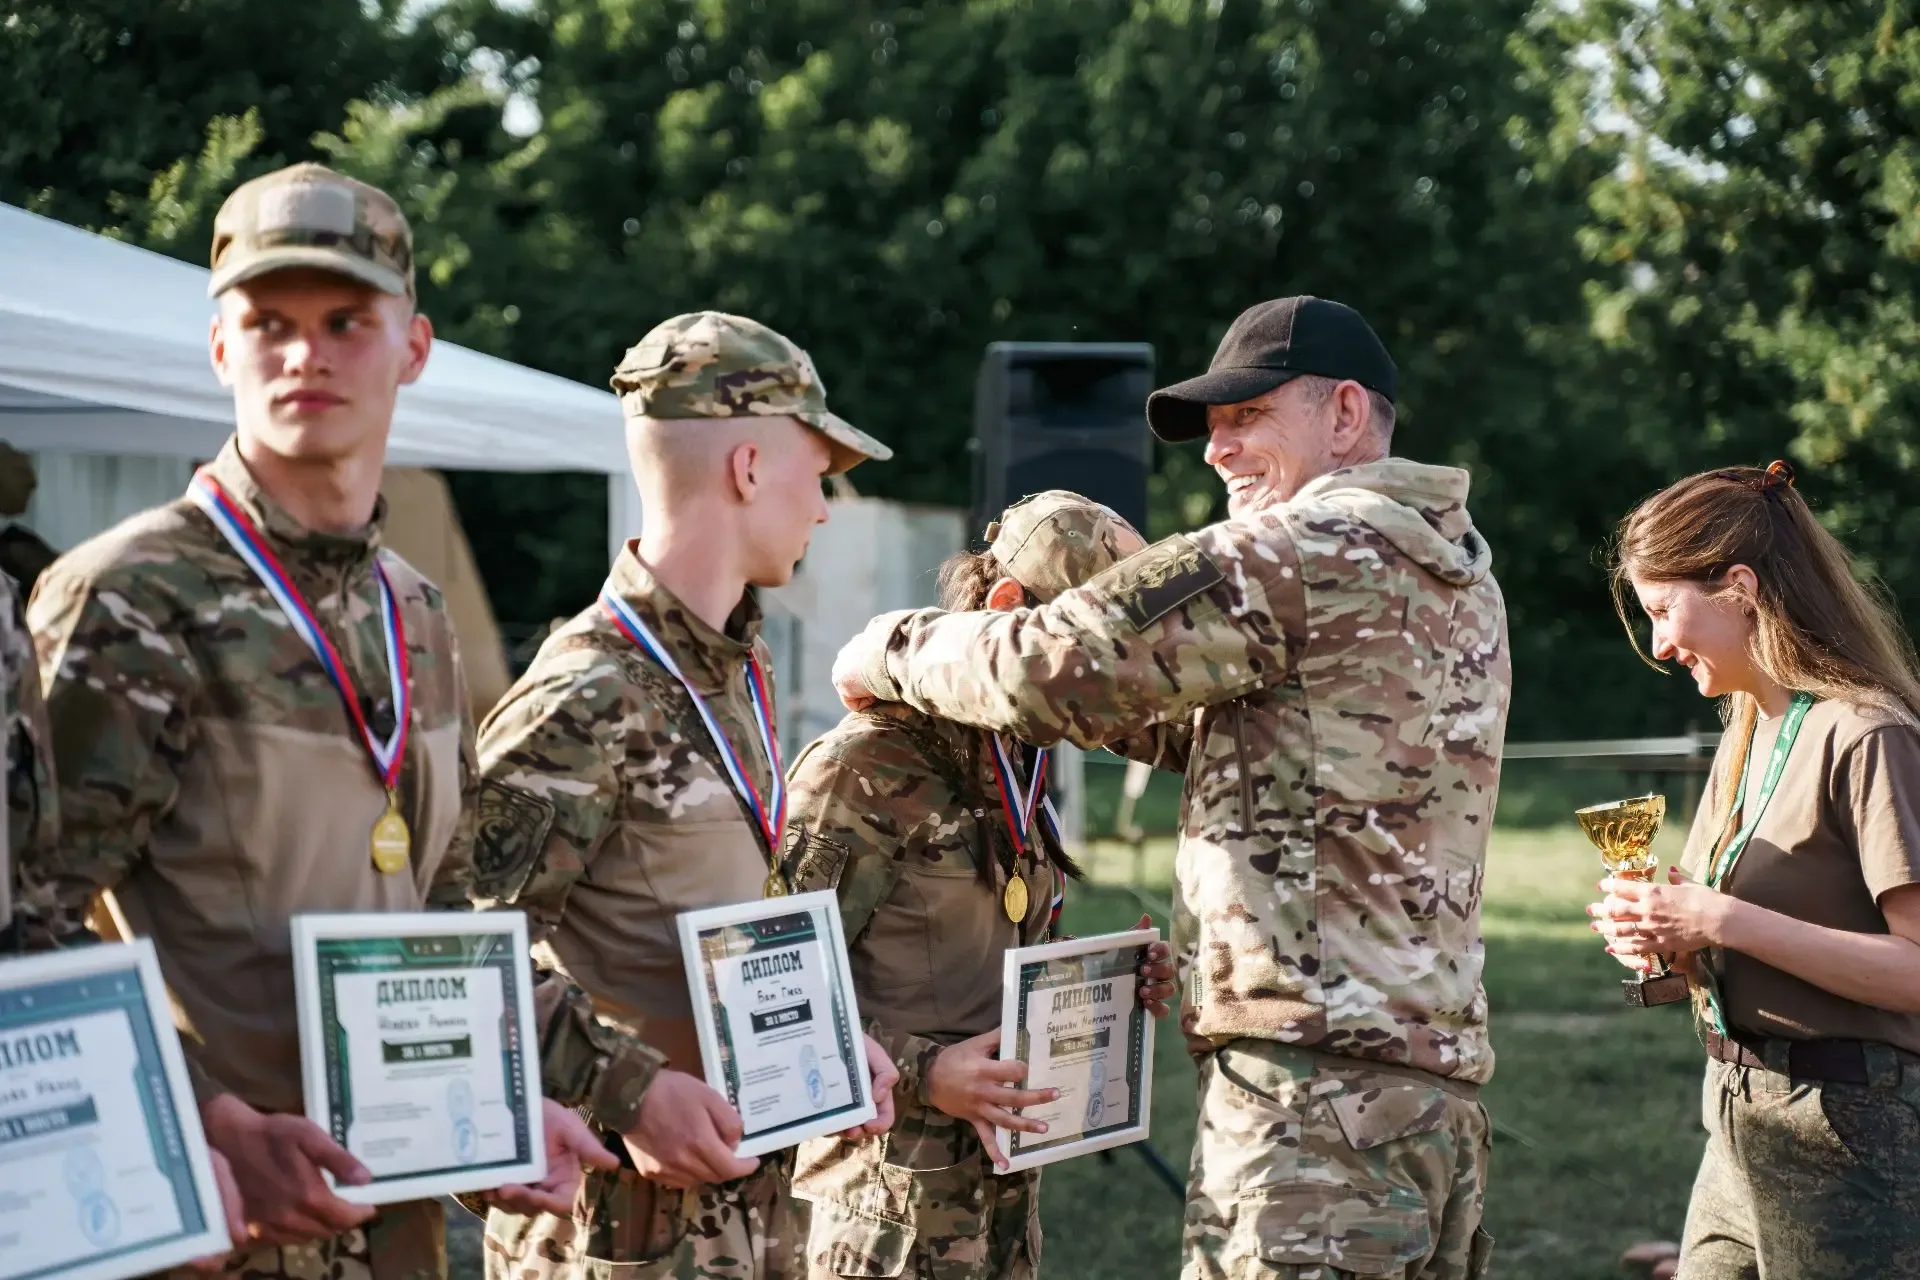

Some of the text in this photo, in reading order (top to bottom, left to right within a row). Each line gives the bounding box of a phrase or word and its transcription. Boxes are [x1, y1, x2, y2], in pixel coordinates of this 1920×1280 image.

[741, 950, 804, 985] ДИПЛОМ
[377, 976, 468, 1008] ДИПЛОМ
[1051, 982, 1113, 1014] ДИПЛОМ
[0, 1028, 82, 1070] ПЛОМ
